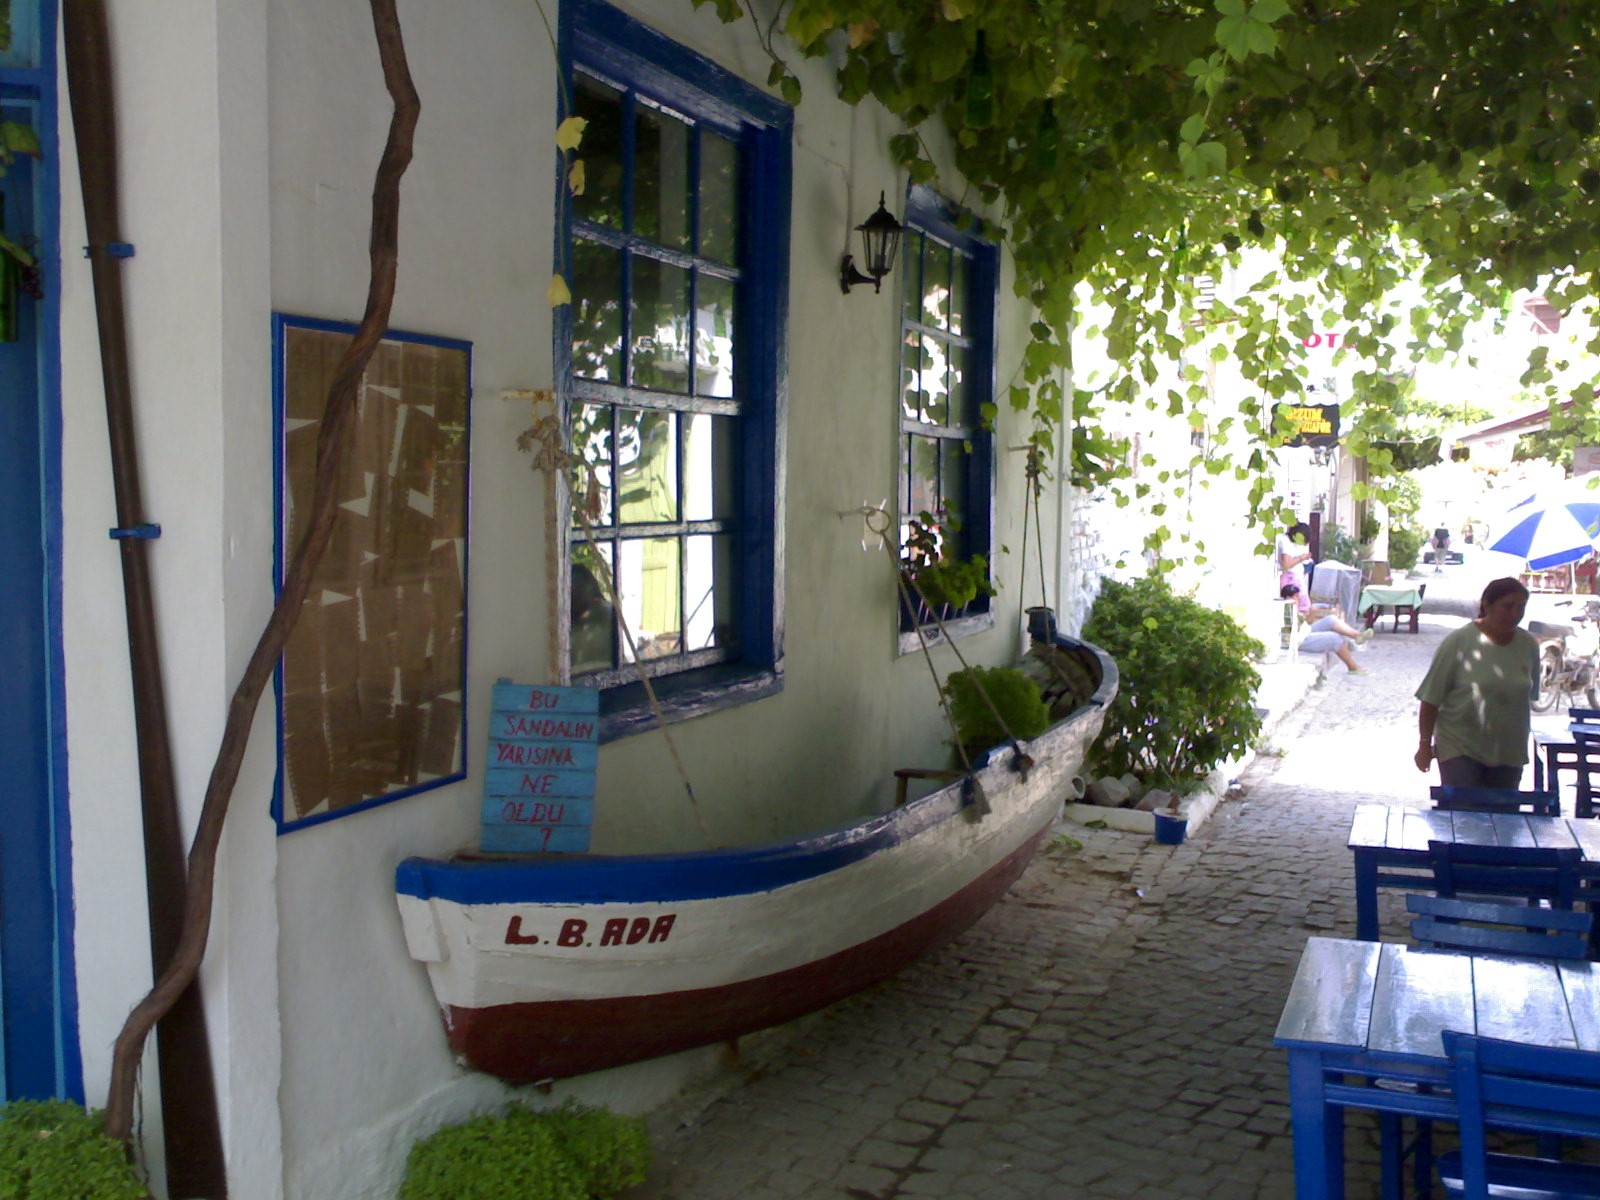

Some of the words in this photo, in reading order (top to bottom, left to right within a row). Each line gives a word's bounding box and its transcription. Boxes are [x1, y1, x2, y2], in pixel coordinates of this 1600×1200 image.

[529, 690, 559, 709] BU
[503, 715, 594, 740] SANDALIN
[496, 743, 575, 767] YARISINA
[521, 773, 558, 793] NE
[502, 801, 565, 824] OLDU
